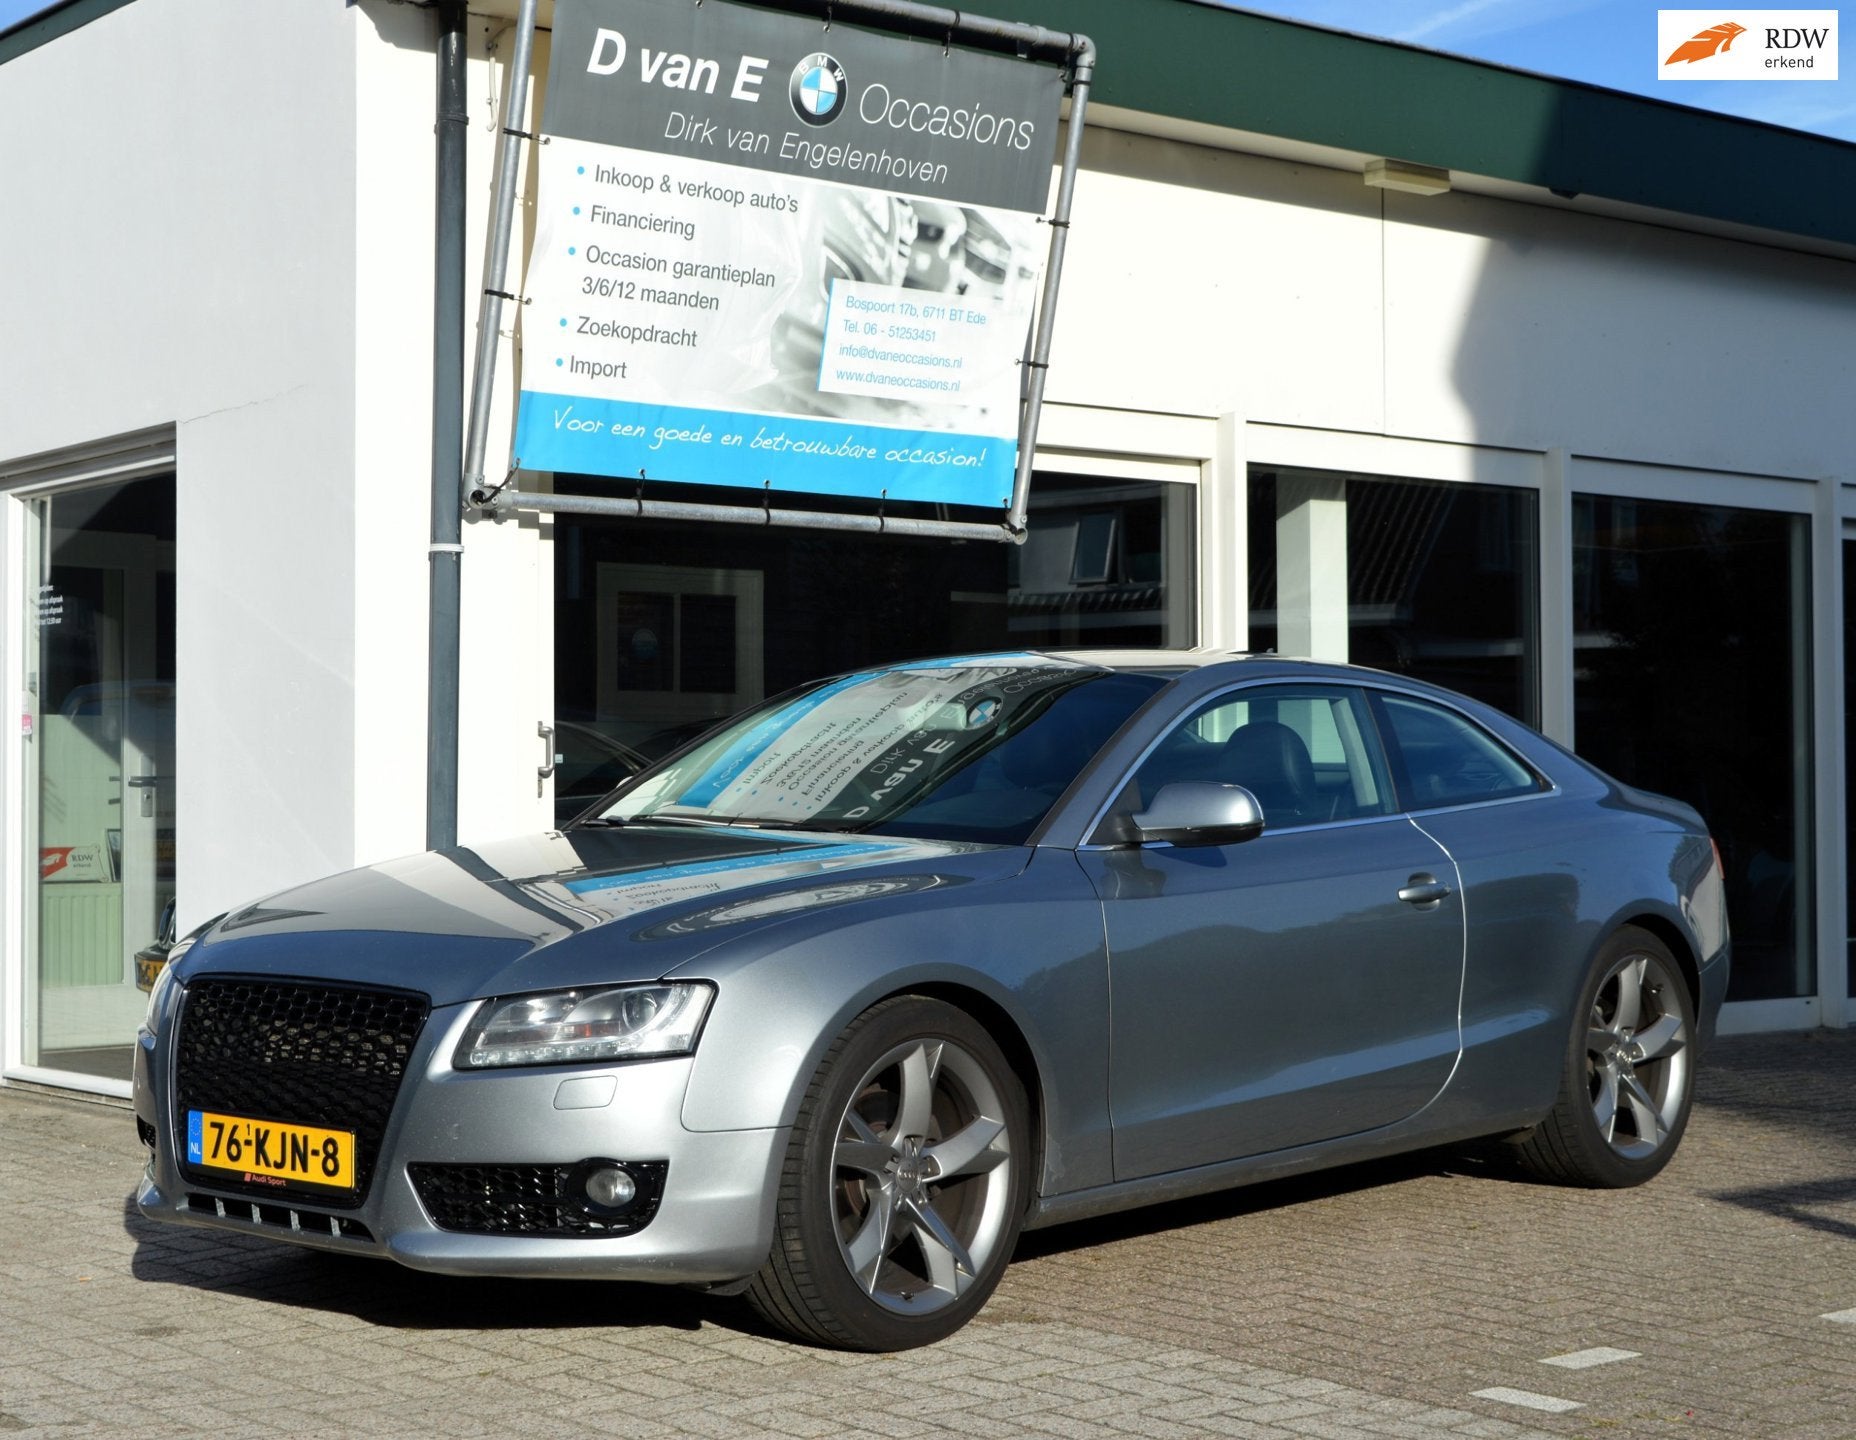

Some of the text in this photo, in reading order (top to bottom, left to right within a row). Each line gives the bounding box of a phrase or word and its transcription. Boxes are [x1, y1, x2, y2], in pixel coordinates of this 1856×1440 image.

[586, 27, 770, 103] D van E
[859, 82, 1035, 151] Occasions
[664, 111, 949, 184] Dirk van Engelenhoven
[594, 164, 799, 213] Inkoop & verkoop auto's
[590, 204, 696, 241] Financiering
[586, 244, 776, 288] Occasion garantieplan
[581, 276, 720, 311] 3/6/12 maanden
[845, 295, 987, 326] Bospoort 17b, 6711 BT Ede
[576, 315, 698, 347] Zoekopdracht
[843, 319, 860, 334] Tel.
[864, 322, 878, 336] 06
[888, 325, 937, 343] 51253451
[569, 355, 627, 380] Import
[839, 343, 963, 369] info@dvaneoccasions.nl
[836, 369, 961, 392] www.dvaneoccasions.nl
[552, 407, 988, 469] Voor een goede en betrouwbare occasion!
[71, 854, 94, 862] RDW
[190, 1142, 201, 1155] NL
[210, 1121, 340, 1178] 76-KJN-8
[252, 1172, 287, 1187] Audi Sport
